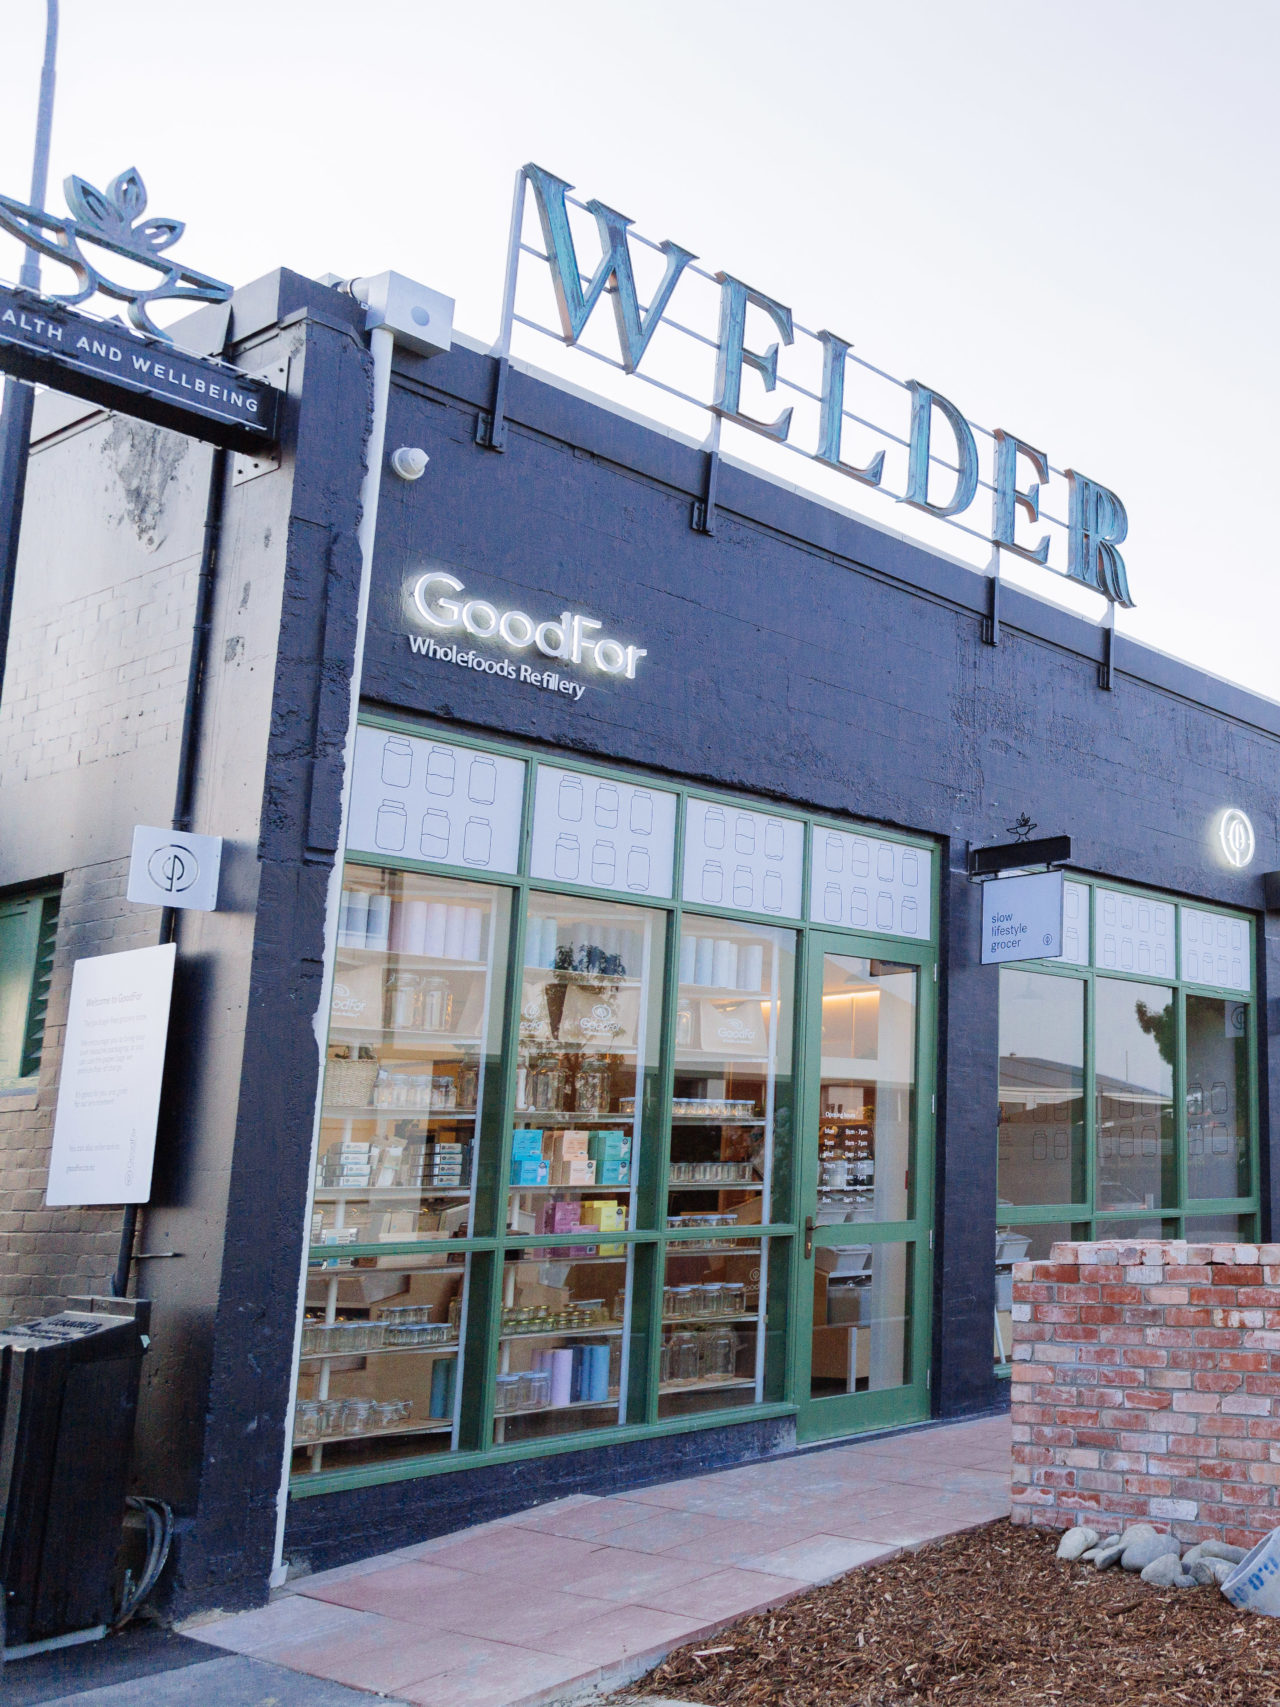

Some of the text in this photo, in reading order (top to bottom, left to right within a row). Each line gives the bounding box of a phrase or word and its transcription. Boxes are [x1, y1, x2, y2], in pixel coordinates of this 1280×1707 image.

[2, 309, 259, 413] ALTH AND WELLBEING
[521, 161, 1136, 608] WELDER
[413, 571, 648, 680] GoodFor
[408, 634, 586, 701] Wholefoods Refillery
[991, 911, 1014, 924] slow
[991, 923, 1028, 937] lifestyle
[990, 938, 1022, 953] grocer
[825, 1111, 843, 1119] Opening
